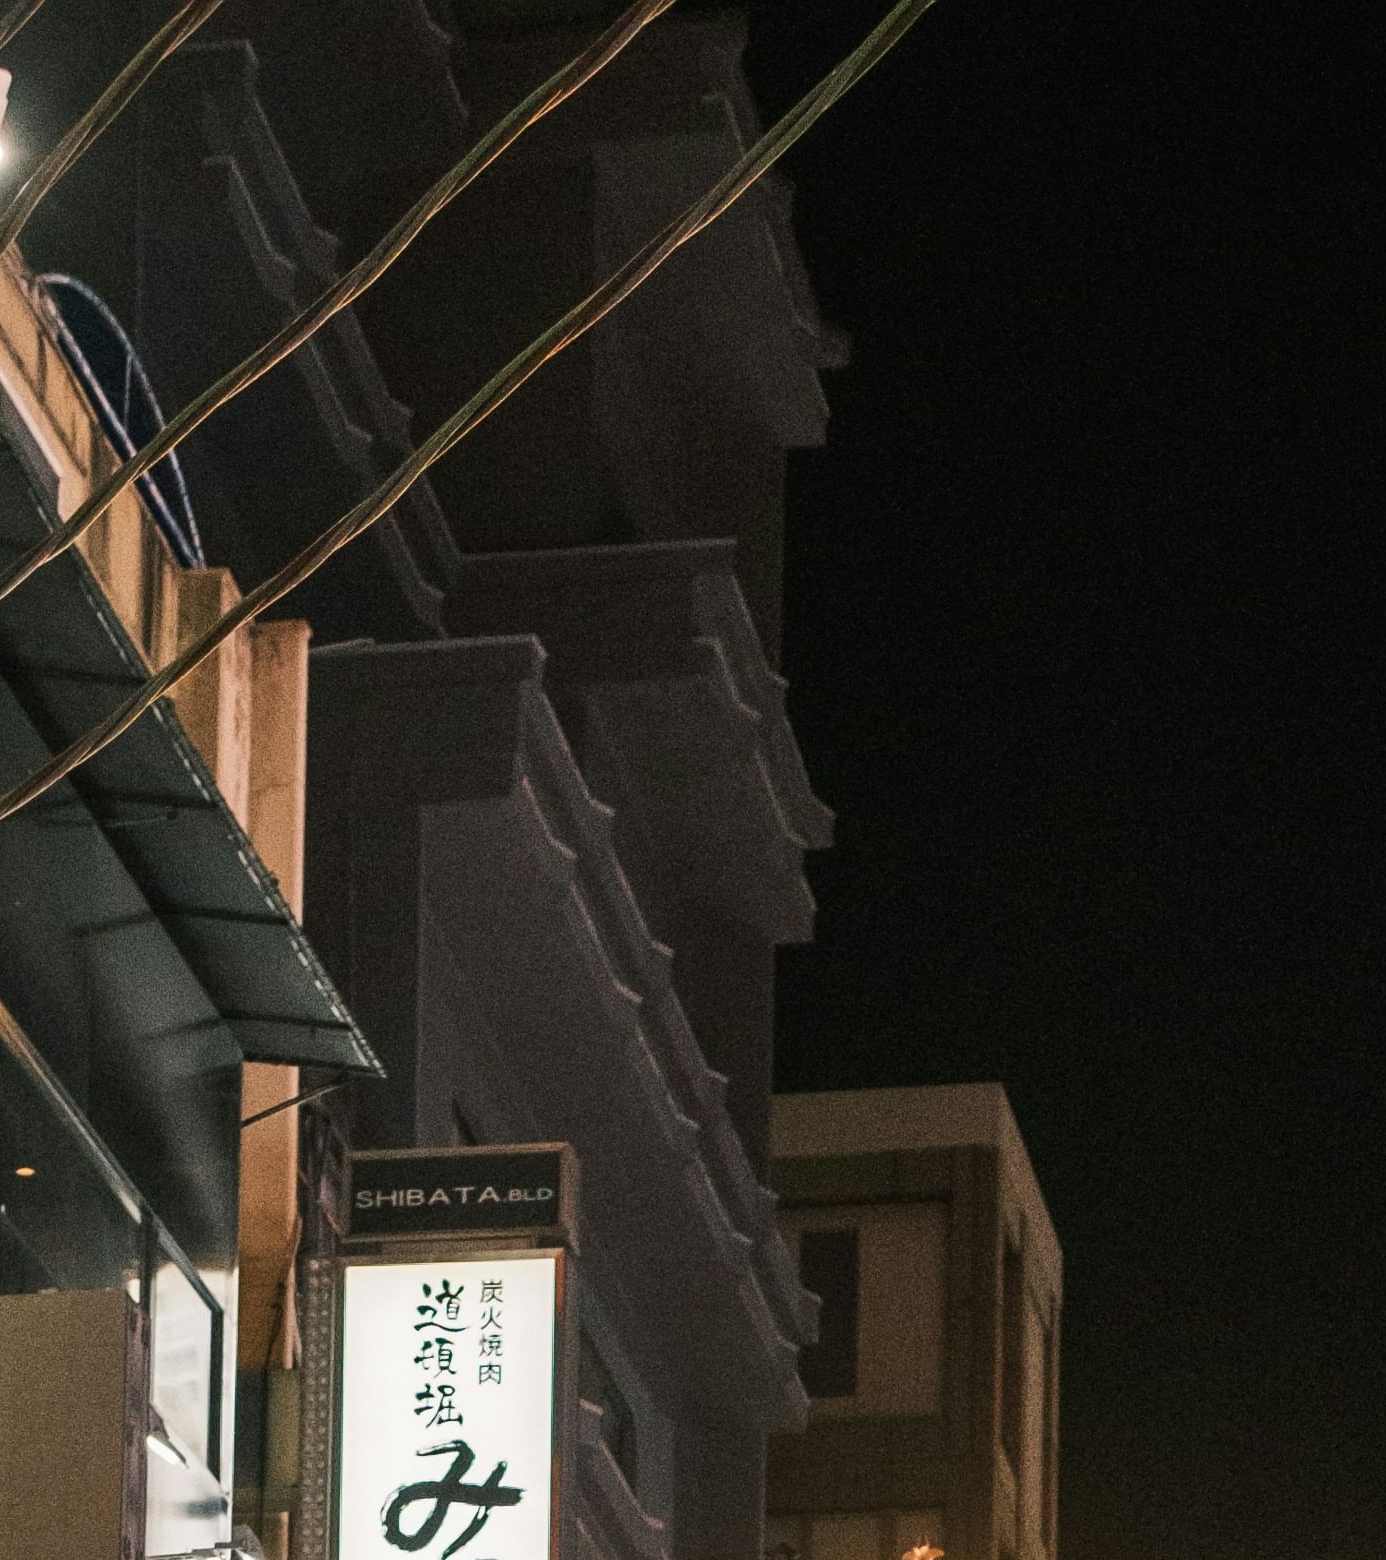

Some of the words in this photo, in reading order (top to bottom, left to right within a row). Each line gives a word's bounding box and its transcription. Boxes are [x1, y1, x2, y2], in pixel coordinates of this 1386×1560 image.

[413, 1279, 474, 1429] 道頓堀
[477, 1278, 505, 1386] 炭火焼肉
